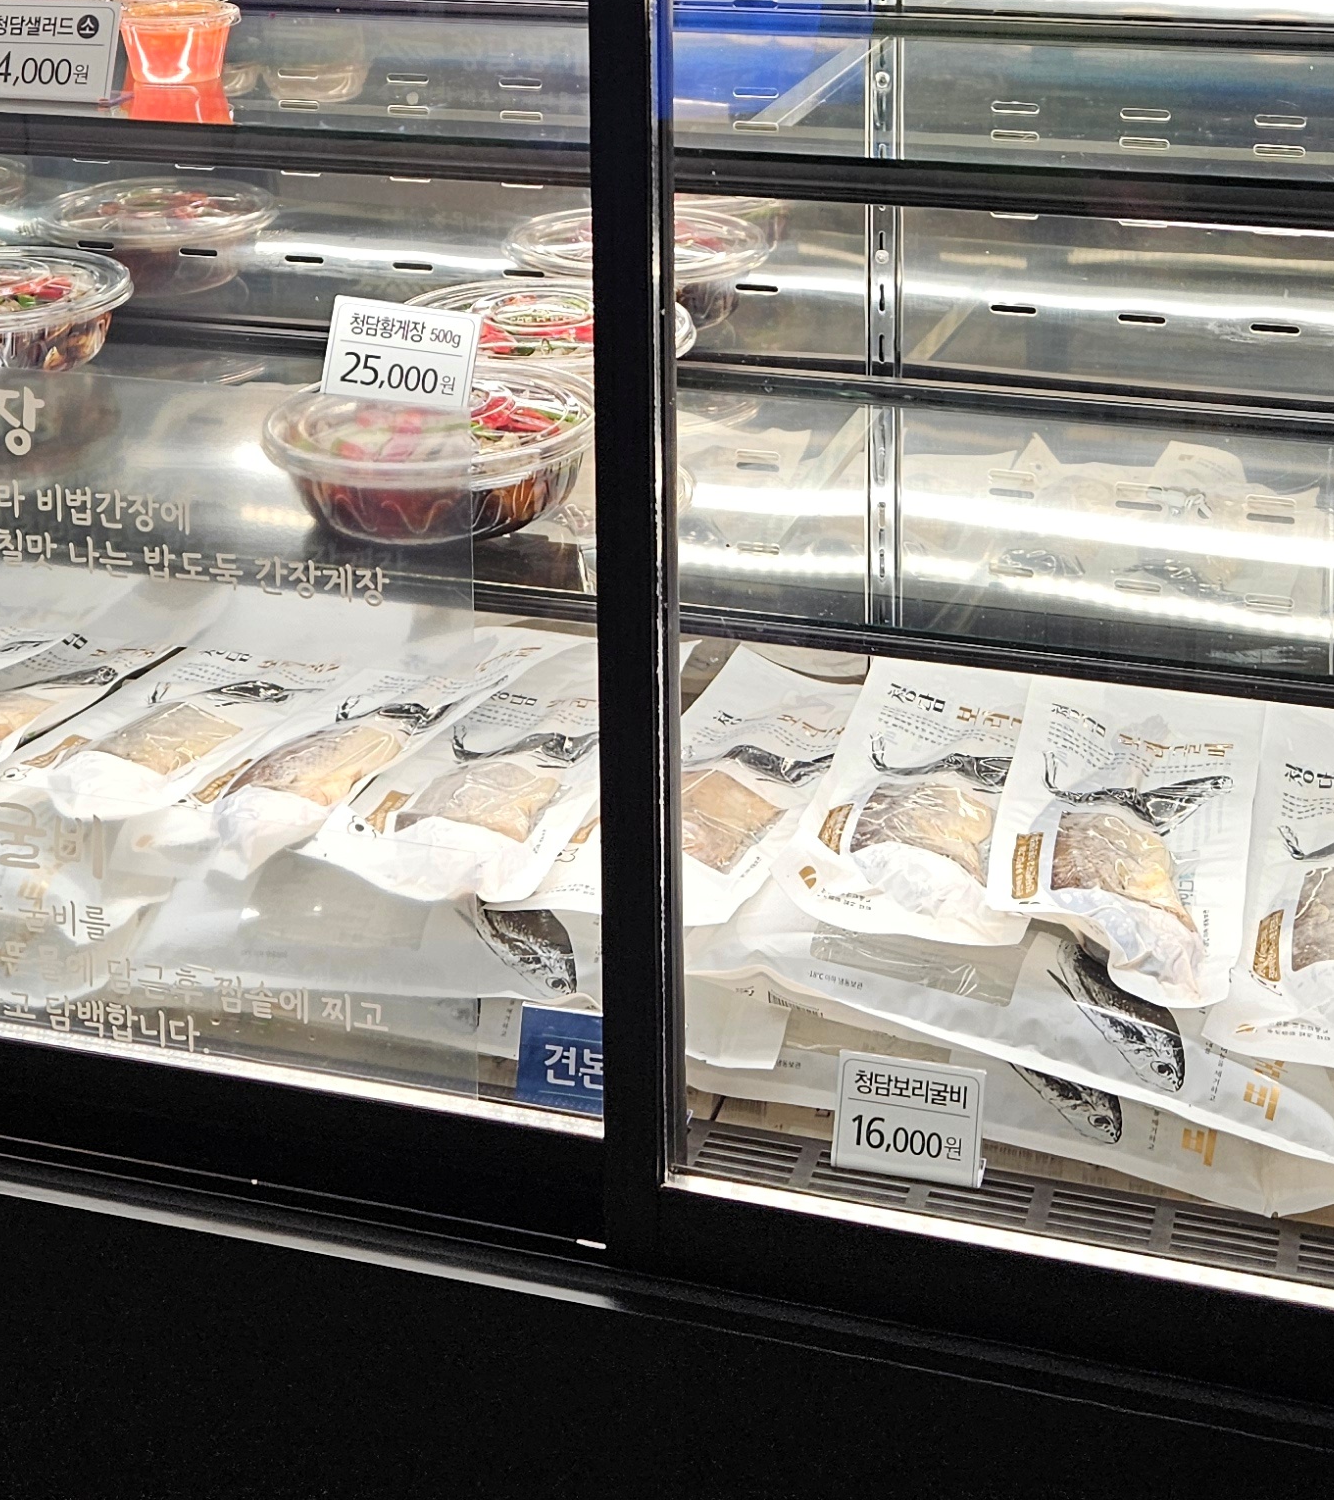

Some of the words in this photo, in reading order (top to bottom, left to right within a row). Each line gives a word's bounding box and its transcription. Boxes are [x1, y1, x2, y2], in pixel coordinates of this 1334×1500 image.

[350, 312, 426, 343] 청담황게장
[430, 328, 461, 348] 500g
[340, 352, 455, 396] 25,000원
[36, 484, 191, 534] 비법간장에
[67, 538, 134, 577] 나는
[143, 544, 244, 590] 밥도둑
[254, 556, 390, 607] 간장게장
[214, 975, 310, 1025] 찜솥에
[321, 993, 390, 1032] 찌고
[854, 1069, 968, 1109] 청담보리굴비
[852, 1114, 962, 1162] 16,000원
